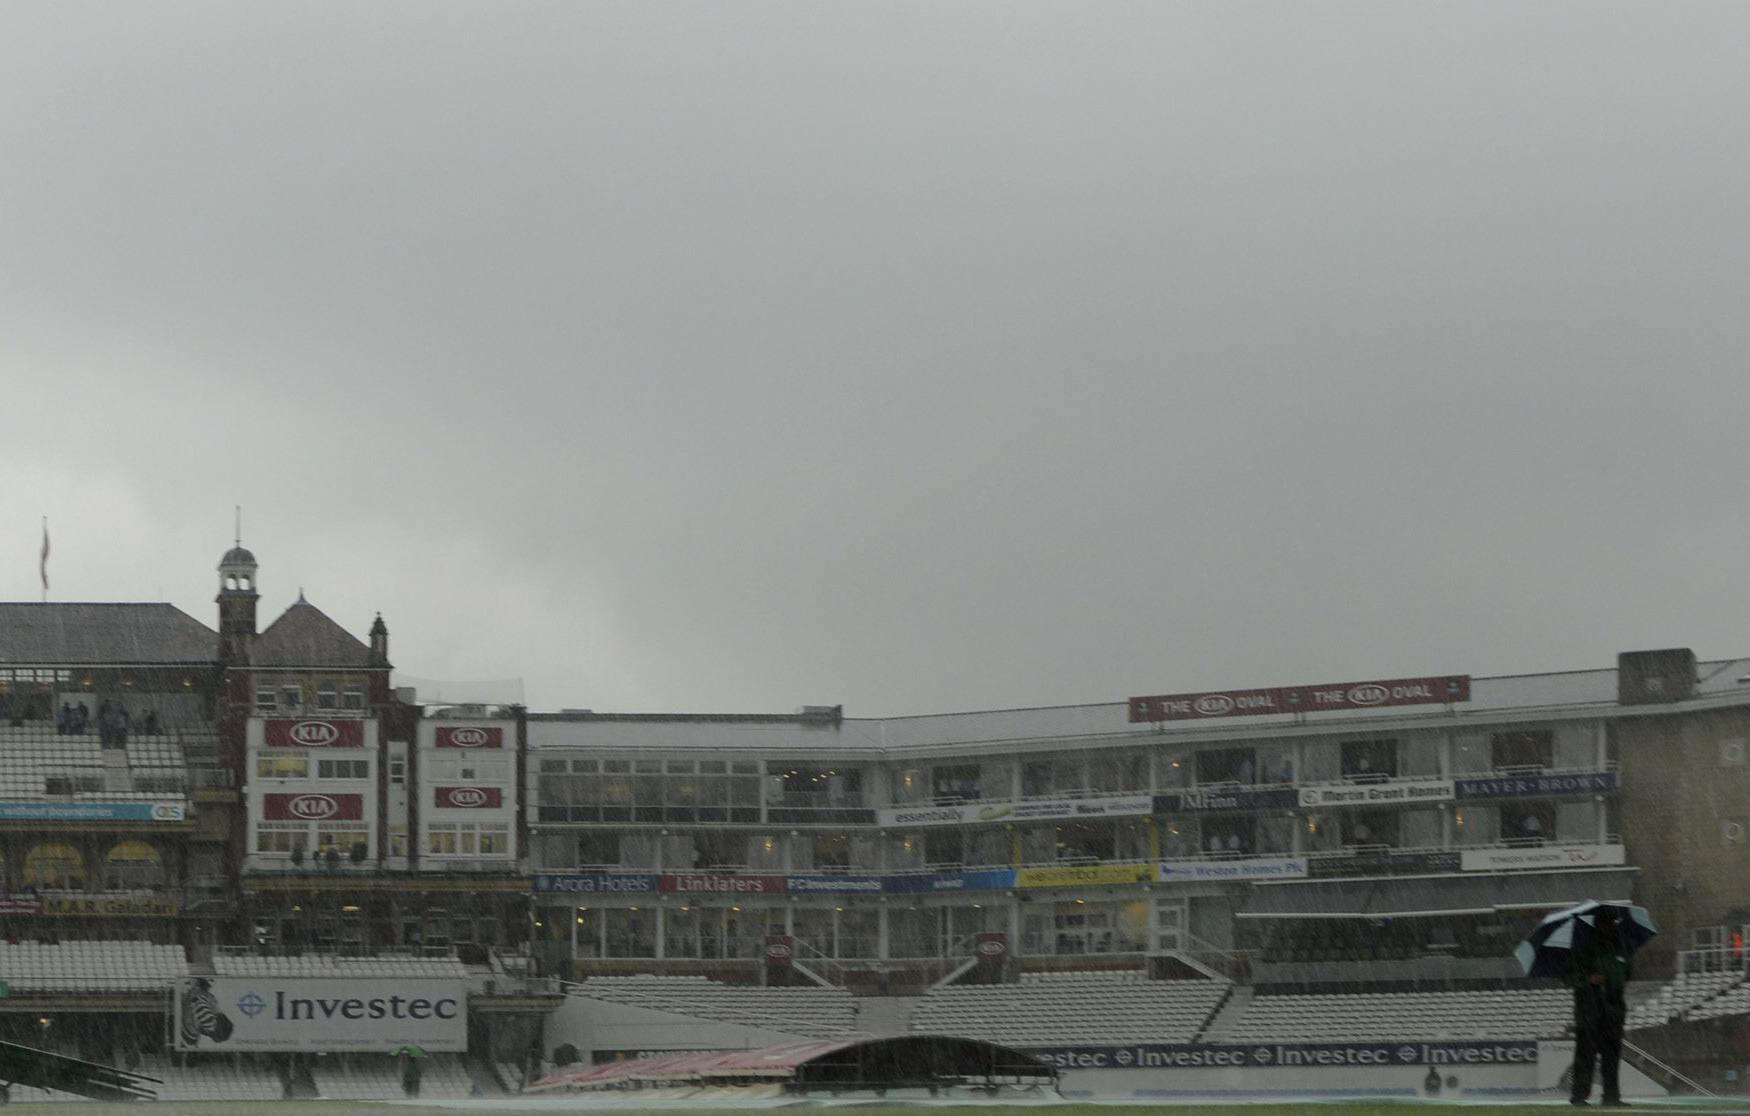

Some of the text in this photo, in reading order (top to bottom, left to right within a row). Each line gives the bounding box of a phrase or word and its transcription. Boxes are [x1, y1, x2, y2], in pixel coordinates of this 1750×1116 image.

[1313, 685, 1433, 703] THE KIA OVAL
[1161, 695, 1275, 713] THE KIA OVAL
[1368, 787, 1404, 800] Grant
[1407, 785, 1451, 798] Homes
[3, 806, 47, 817] without
[553, 875, 650, 892] Arora Hotels
[676, 876, 763, 892] Linklaters
[275, 991, 458, 1020] Investec
[1137, 1048, 1245, 1066] Investec
[1276, 1046, 1389, 1065] Investec
[1422, 1044, 1537, 1063] Investec
